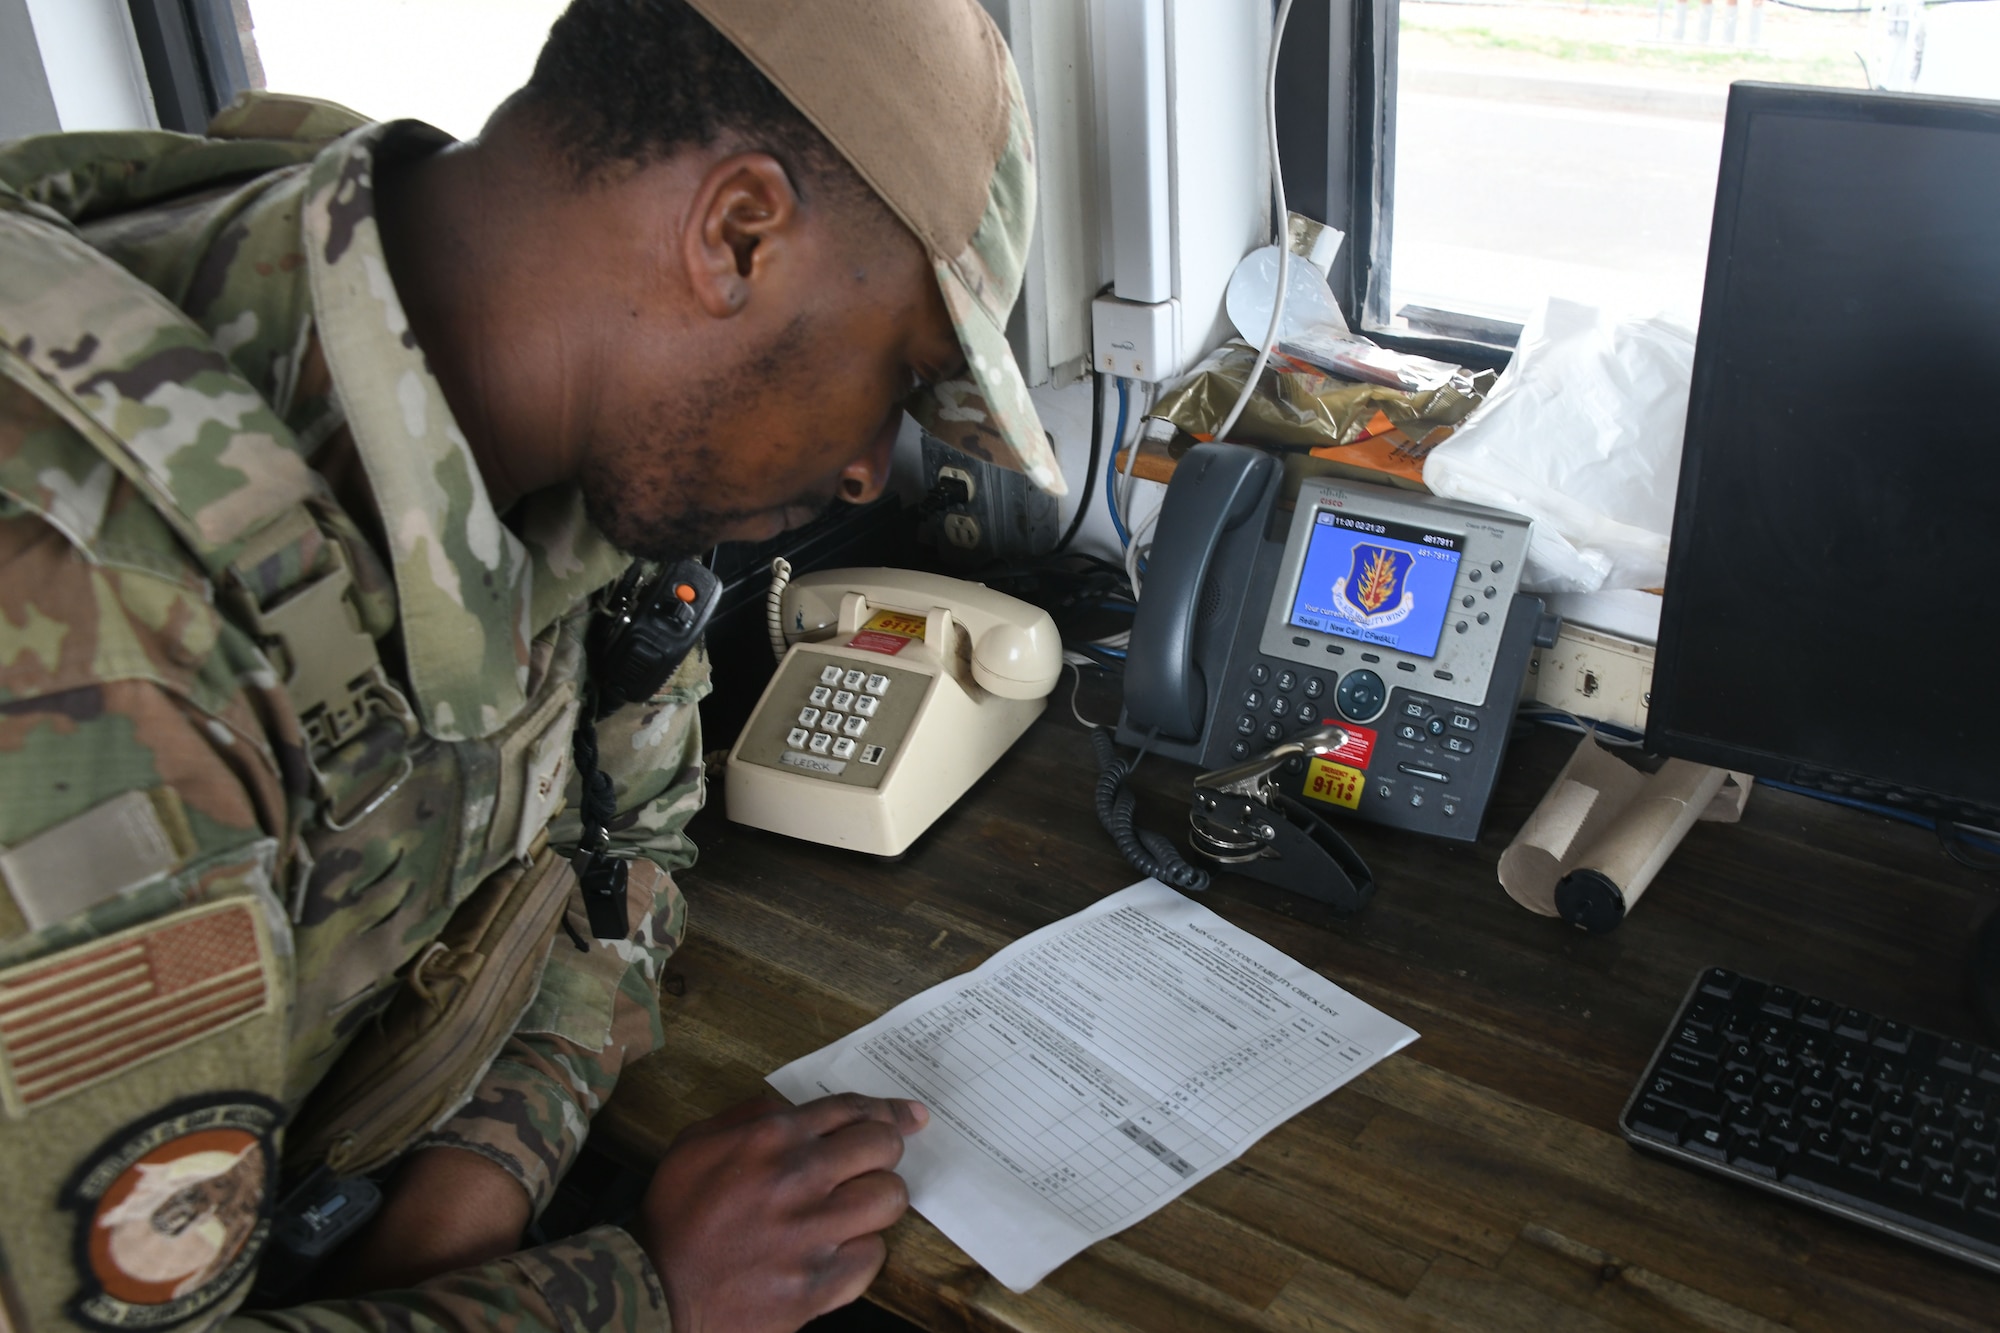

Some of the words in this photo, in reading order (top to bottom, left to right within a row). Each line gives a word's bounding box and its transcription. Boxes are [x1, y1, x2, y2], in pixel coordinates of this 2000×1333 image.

[1335, 517, 1354, 528] 11:00
[1423, 534, 1454, 548] 4817911
[1304, 602, 1319, 613] Your
[1385, 607, 1406, 622] WING
[1299, 616, 1321, 627] Redial
[1330, 620, 1344, 632] New
[1345, 626, 1359, 636] Call
[1256, 669, 1262, 677] 1
[1283, 674, 1290, 683] 2
[1310, 681, 1317, 690] 3
[1249, 693, 1256, 702] 4
[1276, 699, 1283, 708] 5
[1303, 706, 1310, 715] 6
[1243, 718, 1250, 726] 7
[1270, 726, 1277, 734] 8
[1186, 922, 1209, 936] MAIN
[1204, 933, 1229, 948] GATE
[1224, 946, 1294, 988] ACCOUNTABILITY
[1289, 986, 1322, 1005] CHECK
[1316, 1003, 1341, 1017] LIST
[1738, 1045, 1748, 1056] Q
[1776, 1056, 1790, 1068] W
[1735, 1075, 1745, 1084] A
[1813, 1069, 1822, 1080] E
[1772, 1086, 1780, 1095] S
[1852, 1082, 1861, 1092] R
[1811, 1100, 1821, 1108] D
[1893, 1094, 1902, 1104] T
[1740, 1106, 1750, 1115] Z
[1851, 1111, 1859, 1120] F
[1934, 1108, 1943, 1117] Y
[1780, 1118, 1790, 1129] X
[1973, 1121, 1984, 1131] U
[1891, 1125, 1901, 1135] G
[1819, 1132, 1829, 1142] C
[1932, 1138, 1942, 1149] H
[1861, 1146, 1870, 1156] V
[1973, 1152, 1981, 1162] J
[1900, 1159, 1909, 1170] B
[1942, 1173, 1953, 1185] N
[1984, 1188, 1998, 1200] M
